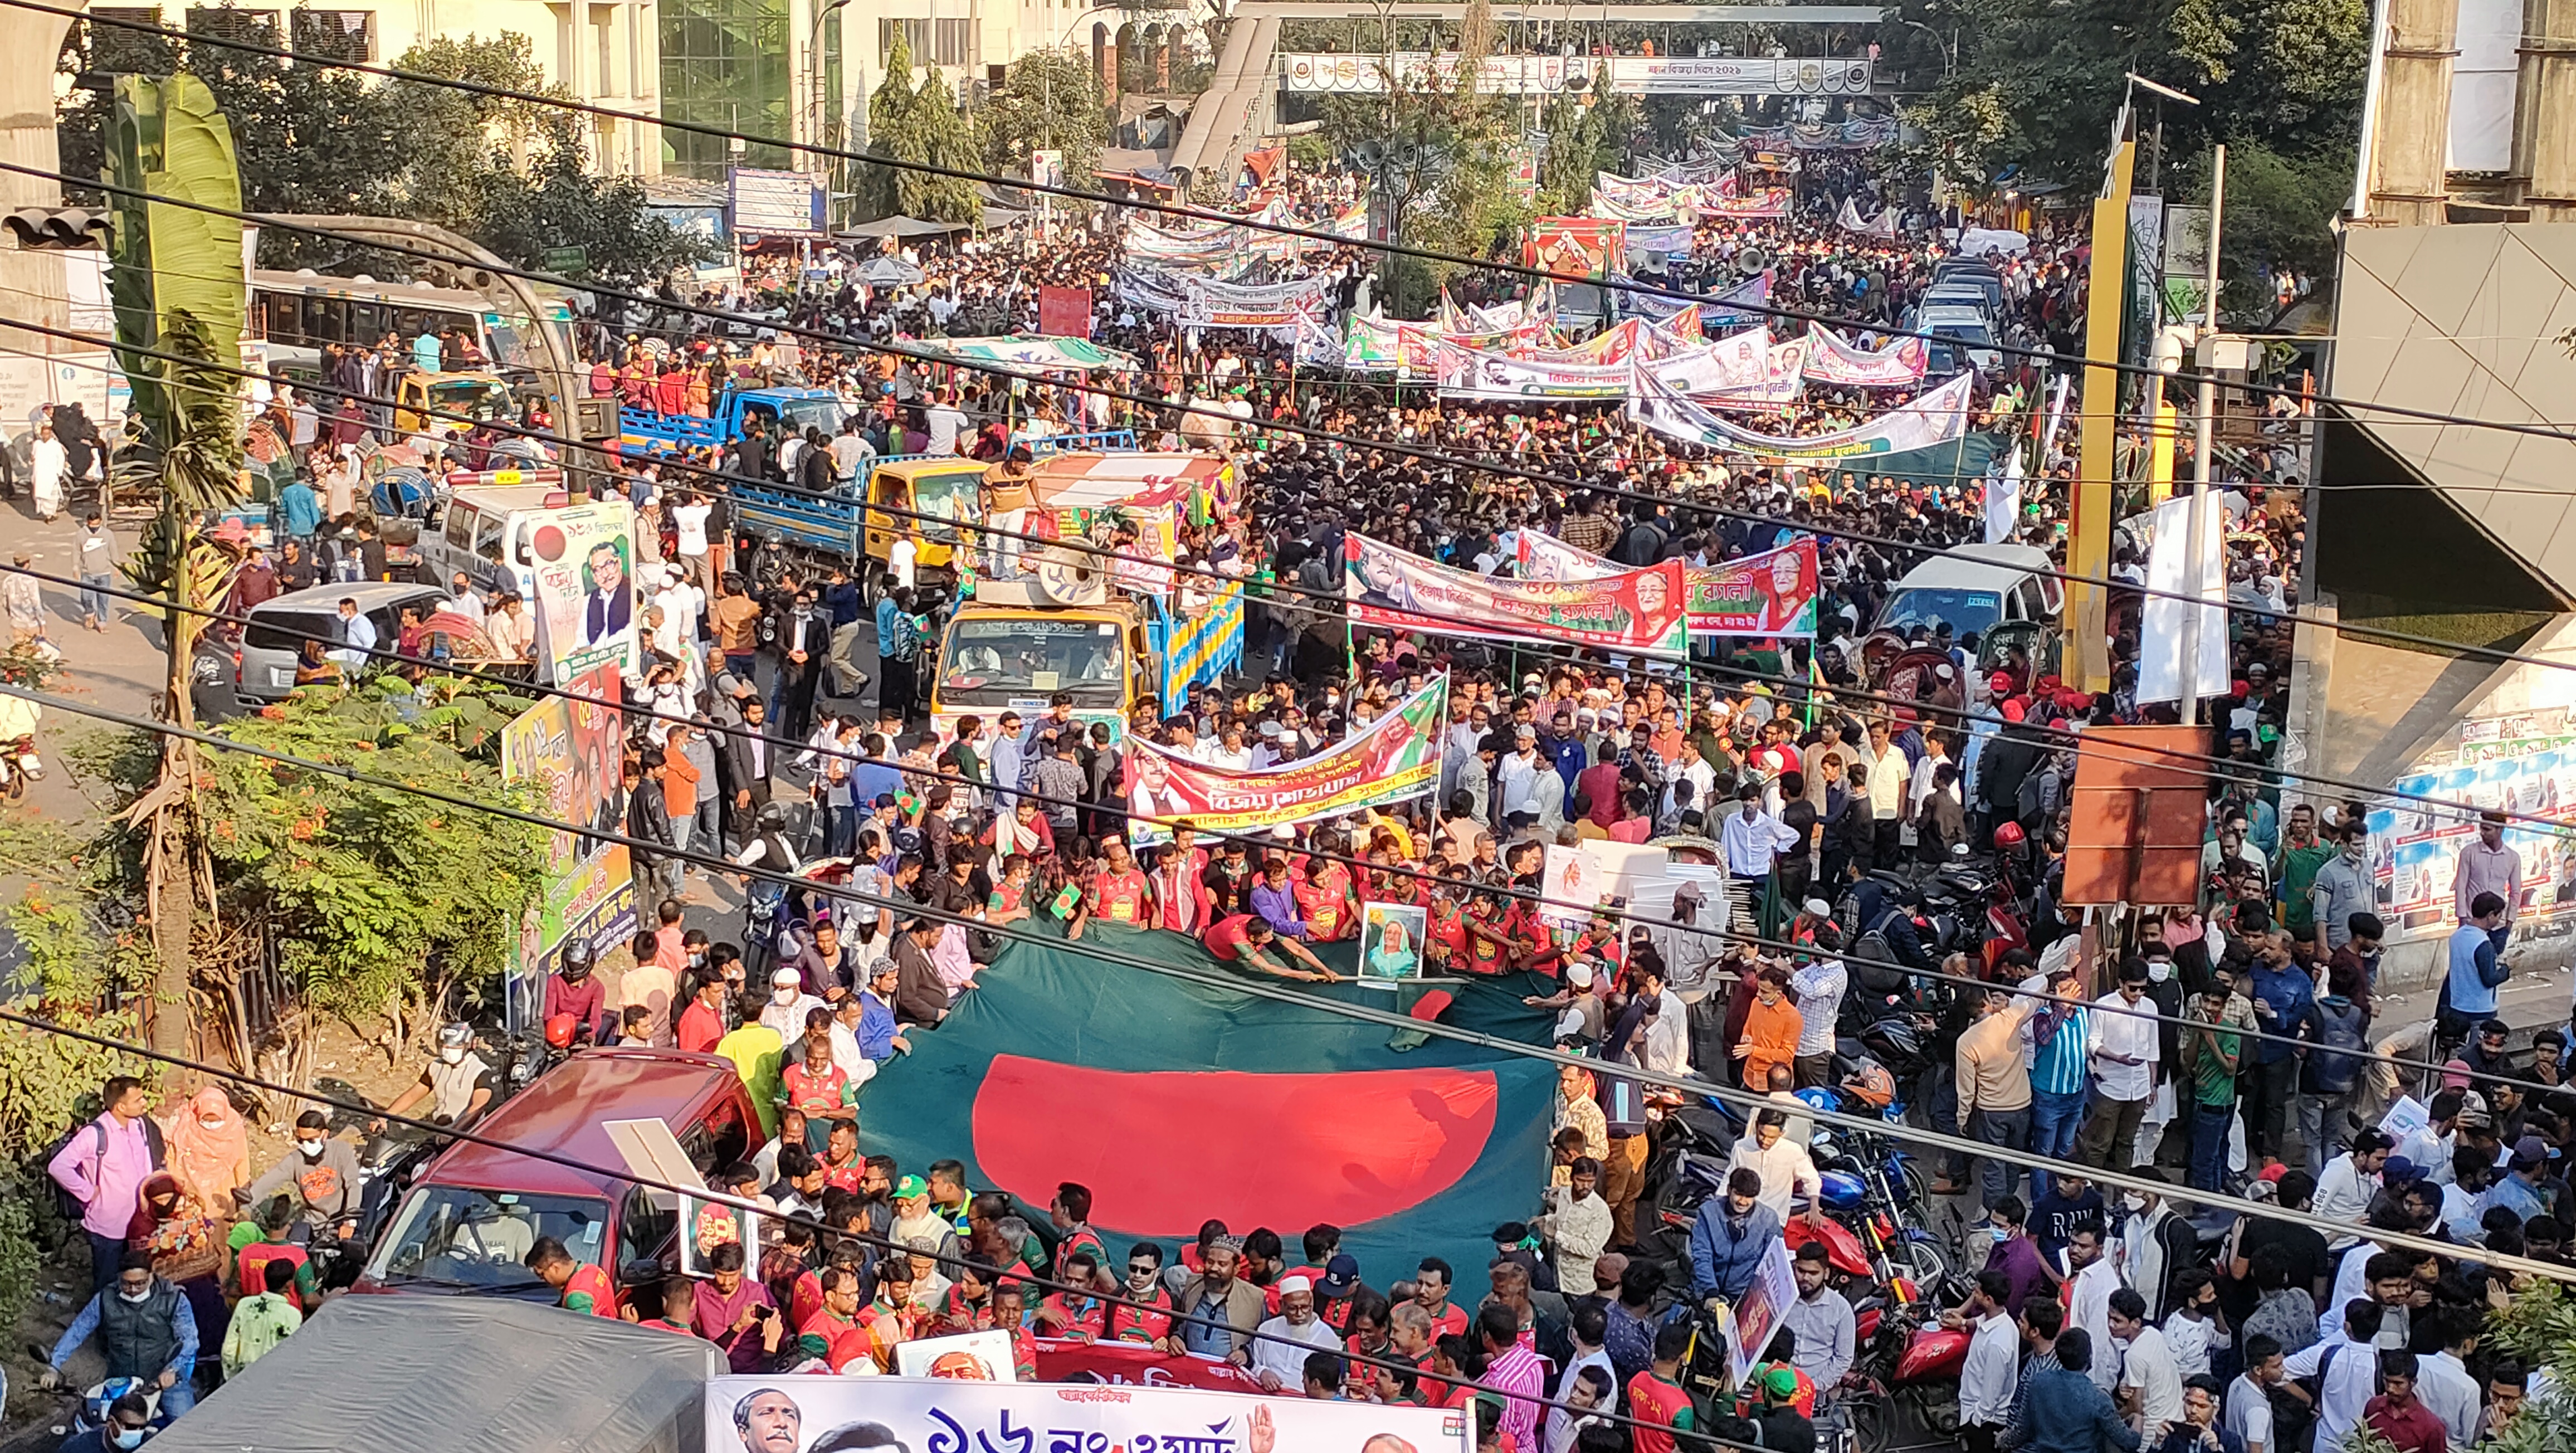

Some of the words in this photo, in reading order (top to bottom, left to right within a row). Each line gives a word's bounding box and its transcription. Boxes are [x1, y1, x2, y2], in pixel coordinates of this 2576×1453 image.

[1208, 790, 1268, 810] বিজয়
[1267, 771, 1363, 812] শোভাযাত্রা
[928, 1407, 1034, 1453] ১৬
